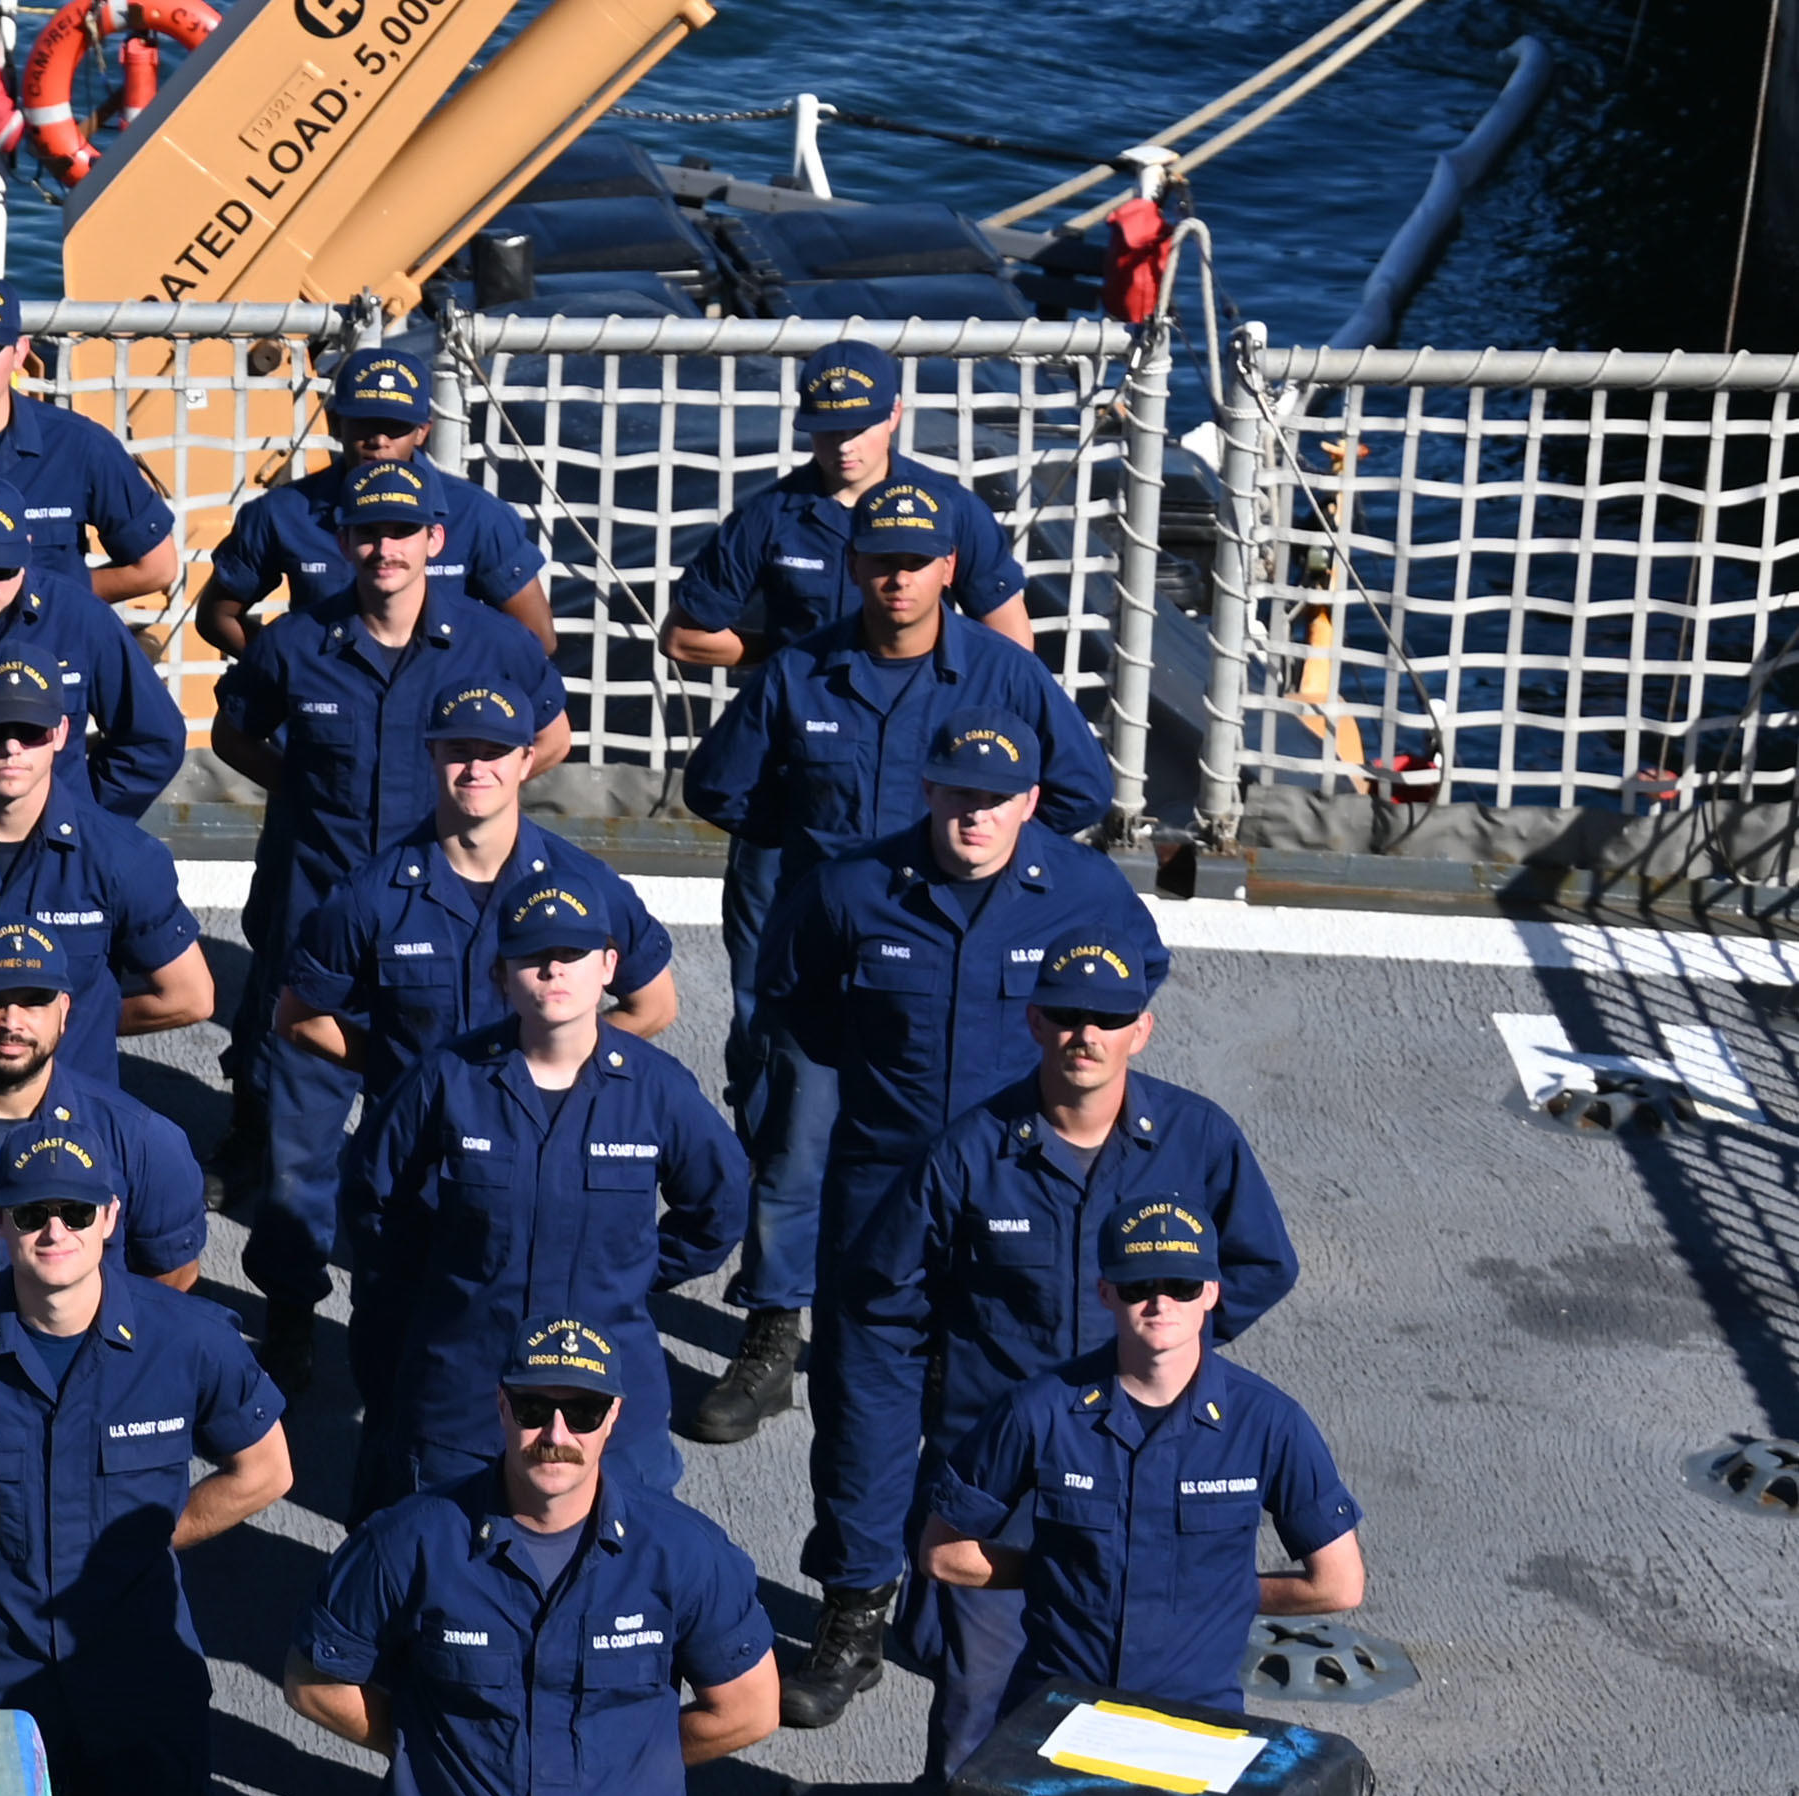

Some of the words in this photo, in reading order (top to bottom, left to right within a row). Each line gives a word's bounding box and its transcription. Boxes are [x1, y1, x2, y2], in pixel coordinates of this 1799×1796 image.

[140, 199, 254, 302] ATED
[245, 78, 363, 200] LOAD:
[352, 0, 446, 76] 5,00
[881, 944, 911, 960] RAMOS
[1120, 1217, 1139, 1234] U.S.
[1138, 1202, 1173, 1220] COAST
[1174, 1207, 1203, 1235] GUARD
[1124, 1240, 1154, 1254] USCGC
[1154, 1240, 1200, 1254] CAMPBELL
[527, 1331, 548, 1347] U.S.
[547, 1318, 581, 1335] COAST
[581, 1327, 611, 1355] GUARD
[528, 1354, 560, 1366] USCGC
[560, 1354, 606, 1374] CAMPBELL
[109, 1424, 128, 1439] U.S.
[127, 1421, 157, 1437] COAST
[156, 1416, 185, 1433] GUARD
[1064, 1472, 1094, 1490] STEAD
[1180, 1480, 1197, 1495] U.S.
[1195, 1479, 1228, 1494] COAST
[1227, 1477, 1258, 1493] GUARD
[592, 1634, 610, 1650] U.S.
[609, 1632, 637, 1649] COAST
[636, 1630, 664, 1646] GUARD
